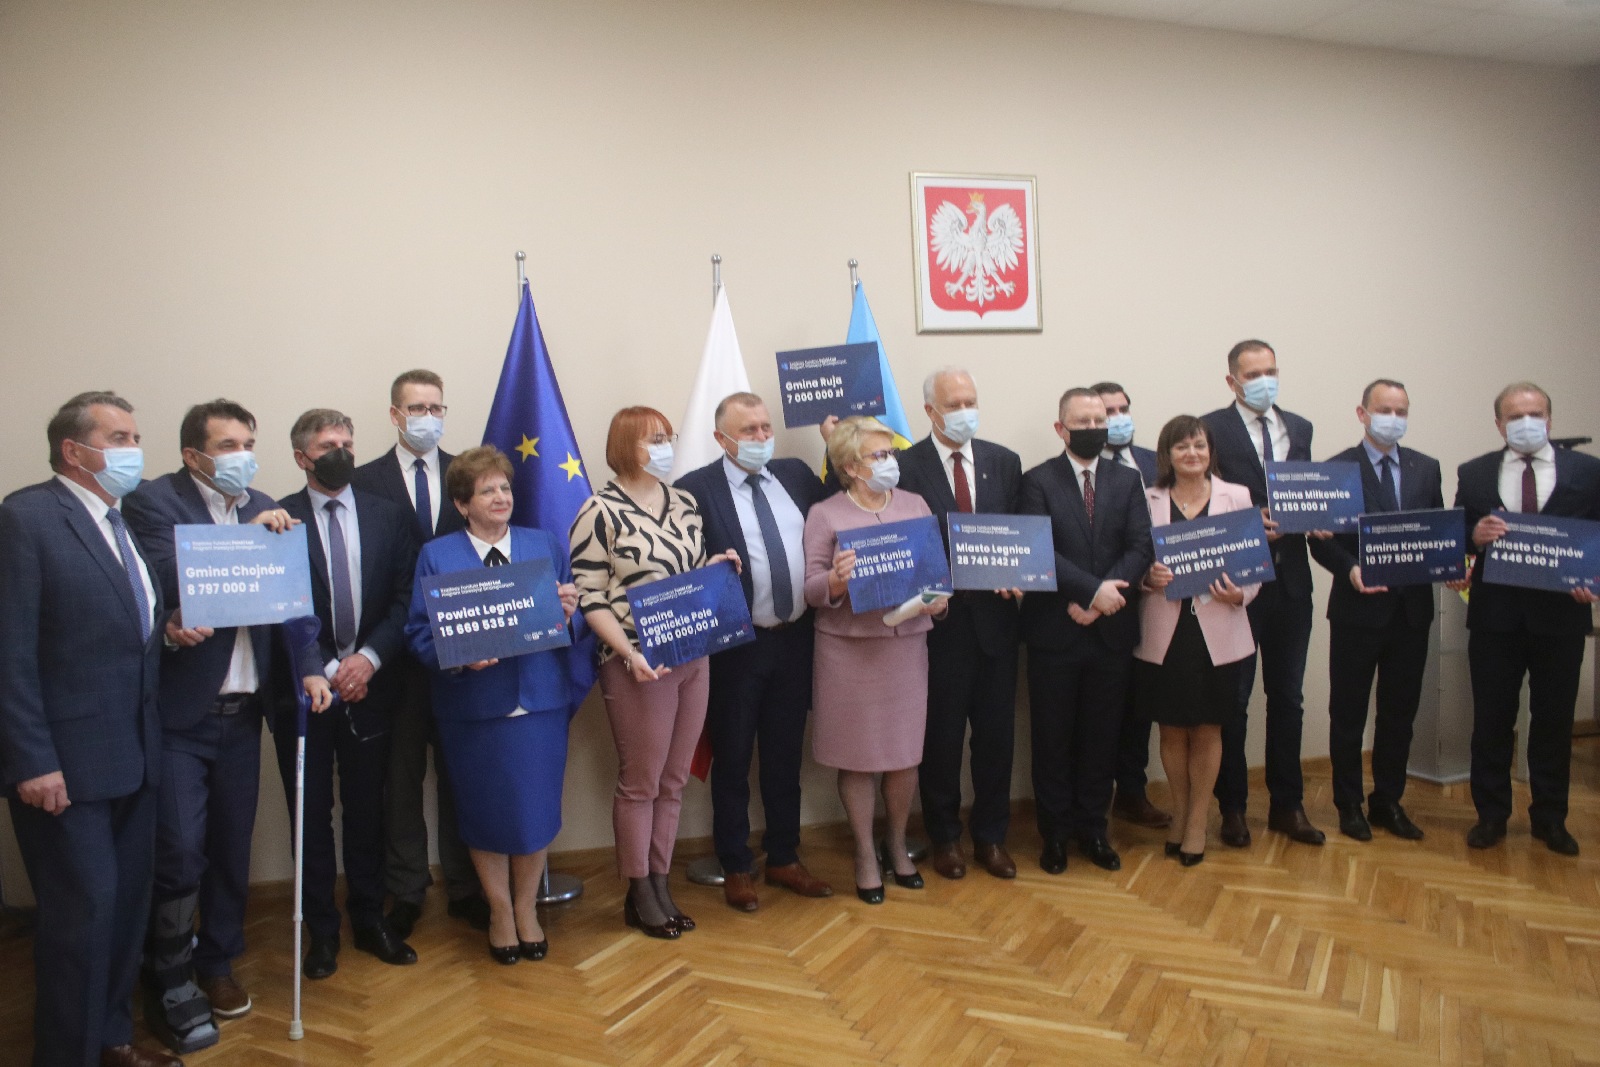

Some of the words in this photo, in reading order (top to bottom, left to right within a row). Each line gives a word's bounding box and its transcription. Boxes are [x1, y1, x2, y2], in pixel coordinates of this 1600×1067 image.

[786, 379, 819, 391] Gmina
[820, 375, 842, 388] Ruja
[787, 395, 793, 404] 7
[795, 391, 813, 403] 000
[815, 389, 833, 400] 000
[1273, 490, 1303, 500] Gmina
[1275, 502, 1280, 512] 4
[1301, 501, 1318, 511] 000
[956, 543, 990, 553] Miasto
[992, 544, 1031, 556] Legnica
[1163, 550, 1198, 565] Gmina
[1200, 538, 1260, 558] Prochowice
[1365, 542, 1398, 553] Gmina
[1401, 539, 1457, 551] Krotoszyce
[1493, 539, 1531, 552] Miasto
[1533, 543, 1584, 559] Chojnów
[855, 556, 878, 567] mina
[880, 549, 912, 562] Kunice
[991, 557, 1008, 566] 242
[1366, 555, 1376, 565] 10
[1378, 554, 1392, 565] 177
[1491, 550, 1499, 560] 4
[1525, 554, 1546, 566] 000
[185, 565, 229, 578] Gmina
[231, 563, 285, 579] Chojnów
[187, 584, 195, 595] 8
[198, 583, 219, 595] 797
[222, 582, 246, 593] 000
[249, 581, 259, 593] zł
[437, 606, 481, 622] Powiat
[483, 596, 535, 615] Legnicki
[440, 626, 454, 637] 15
[456, 621, 479, 635] 669
[482, 617, 505, 631] 535
[508, 614, 518, 627] zł
[640, 609, 674, 626] Gmina
[643, 614, 690, 637] Legnickie
[691, 608, 712, 622] Pole
[647, 638, 653, 647] 4
[675, 621, 708, 639] 000,00
[710, 617, 719, 628] zł
